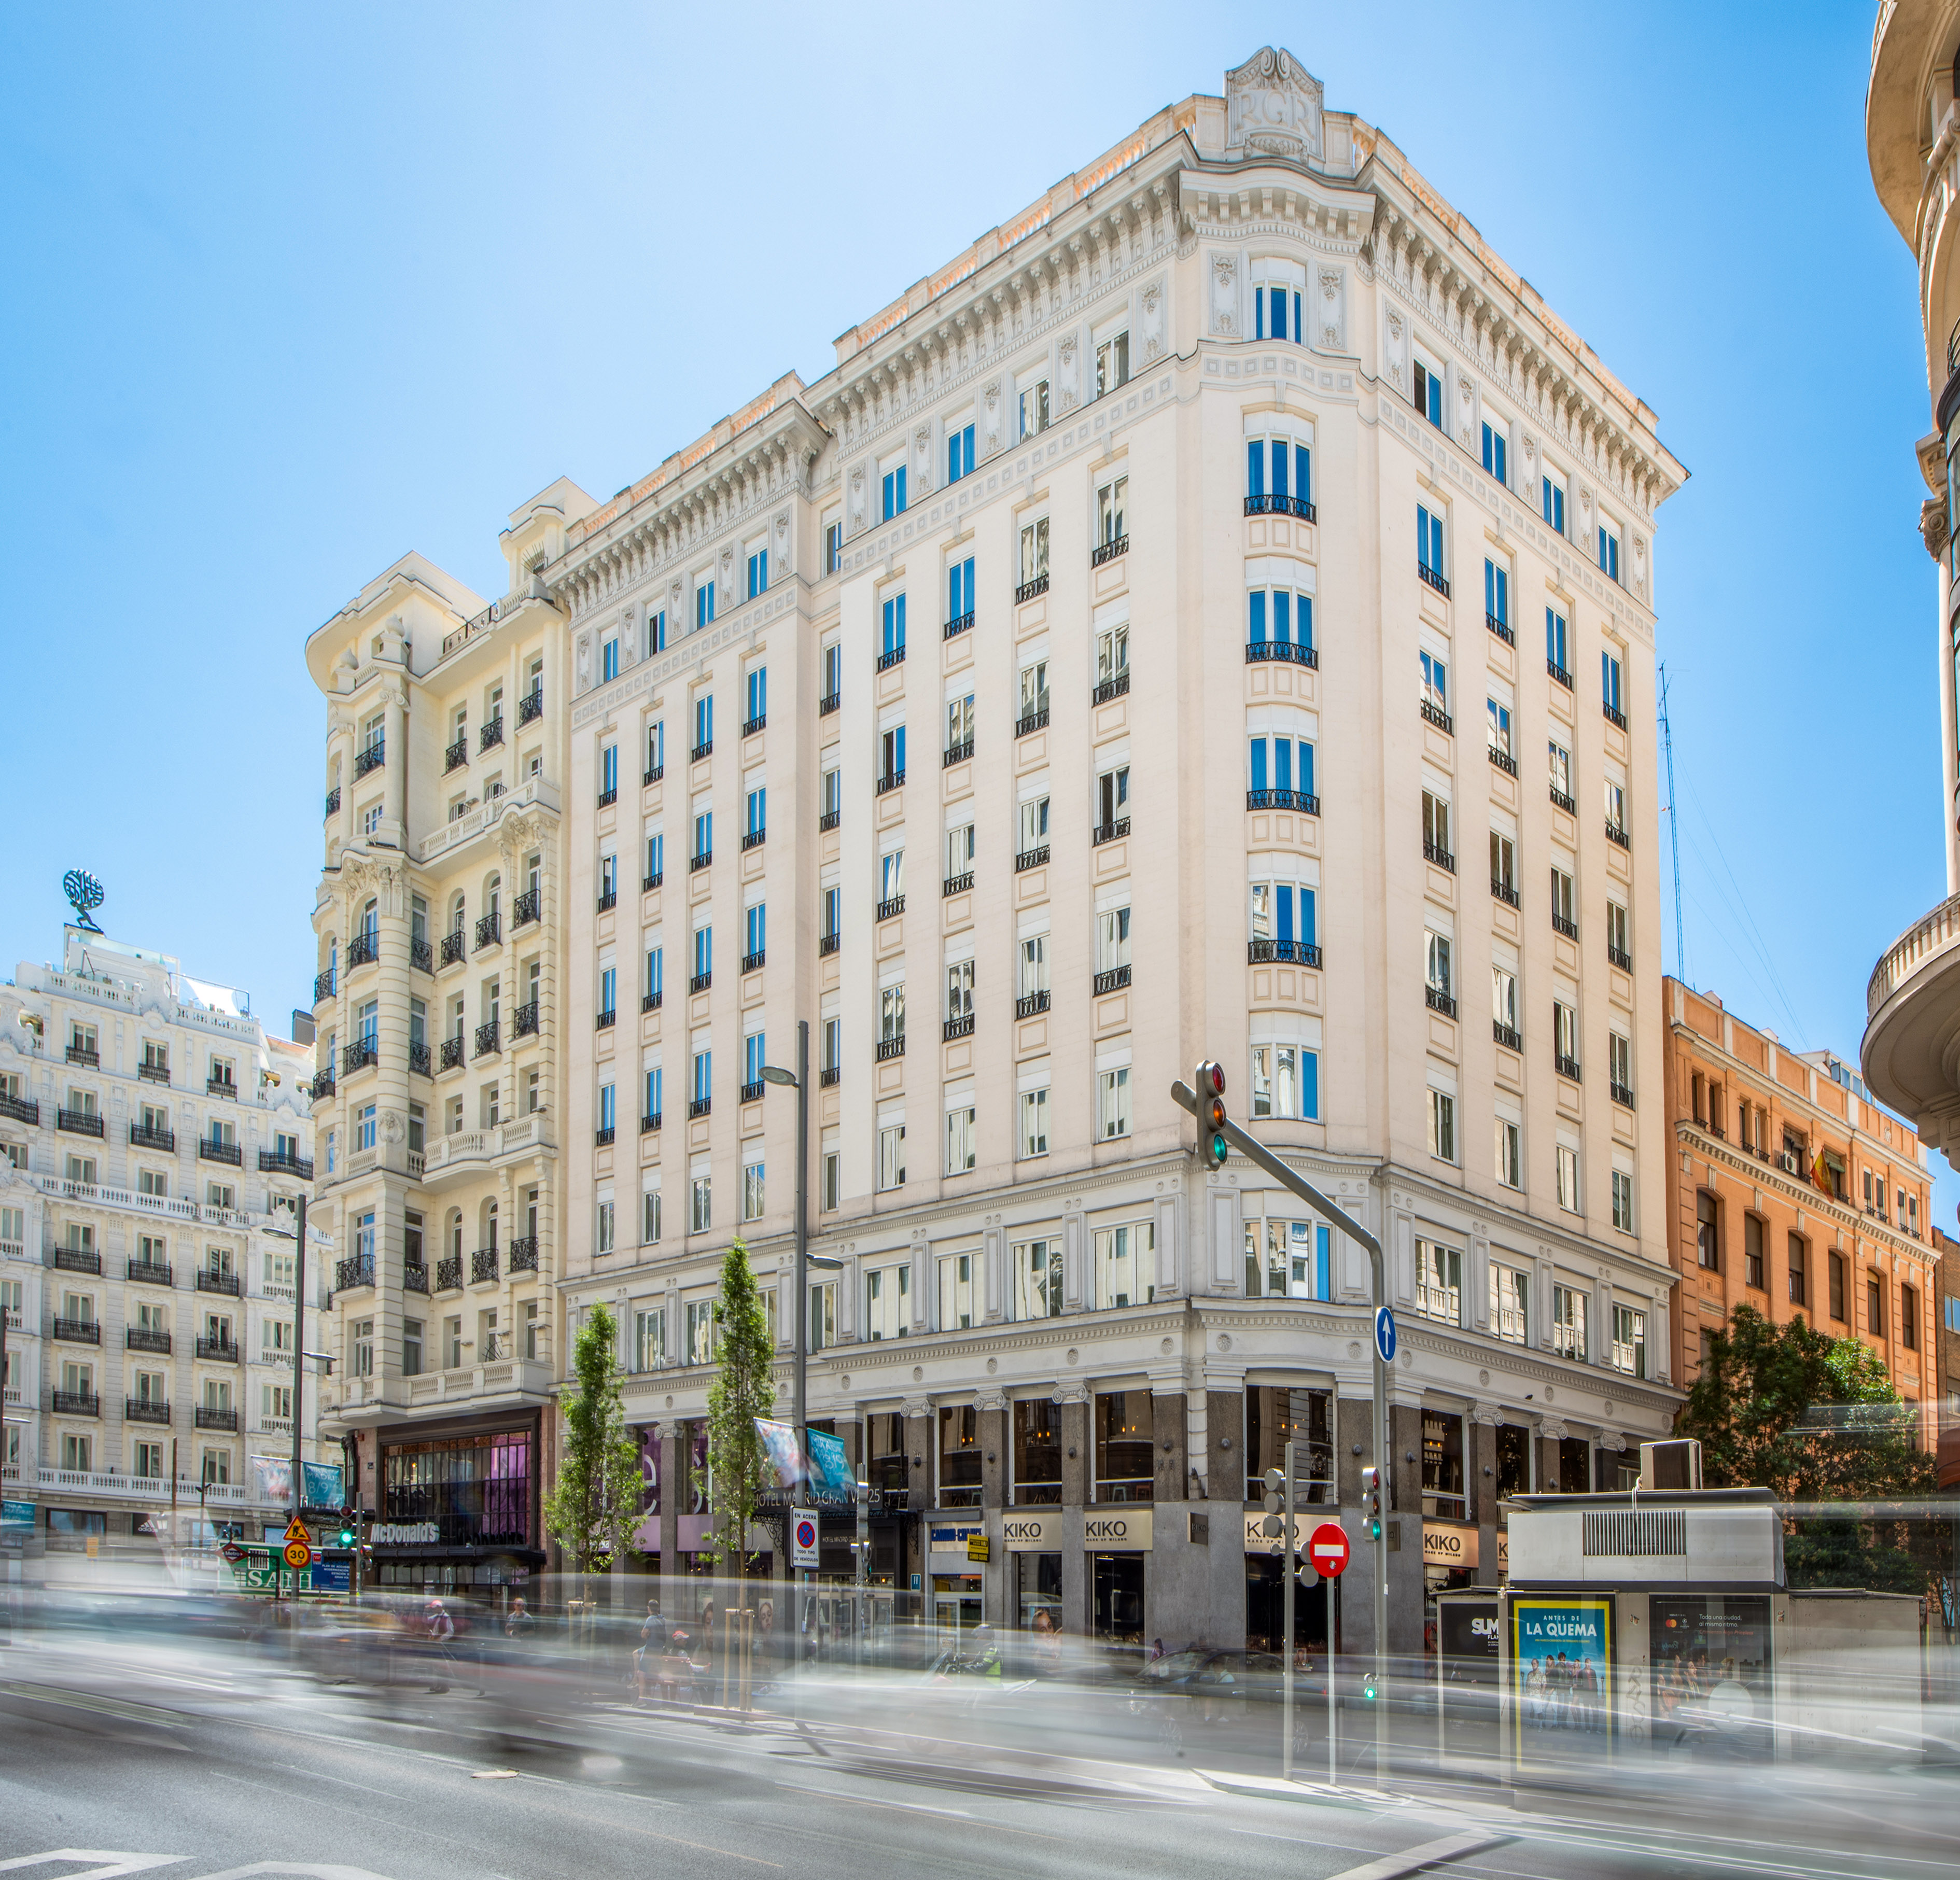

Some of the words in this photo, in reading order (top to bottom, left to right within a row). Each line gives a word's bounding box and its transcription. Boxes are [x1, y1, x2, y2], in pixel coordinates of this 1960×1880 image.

[783, 1491, 820, 1506] MARID
[822, 1490, 848, 1505] GRAN
[868, 1489, 880, 1503] 25
[370, 1522, 440, 1542] McDonald's
[1004, 1522, 1042, 1538] KIKO
[1086, 1520, 1127, 1536] KIKO
[1192, 1522, 1207, 1532] KIKO
[1424, 1533, 1461, 1552] KIKO
[290, 1550, 305, 1559] 30
[1526, 1623, 1543, 1635] LA
[1546, 1623, 1597, 1637] QUEMA
